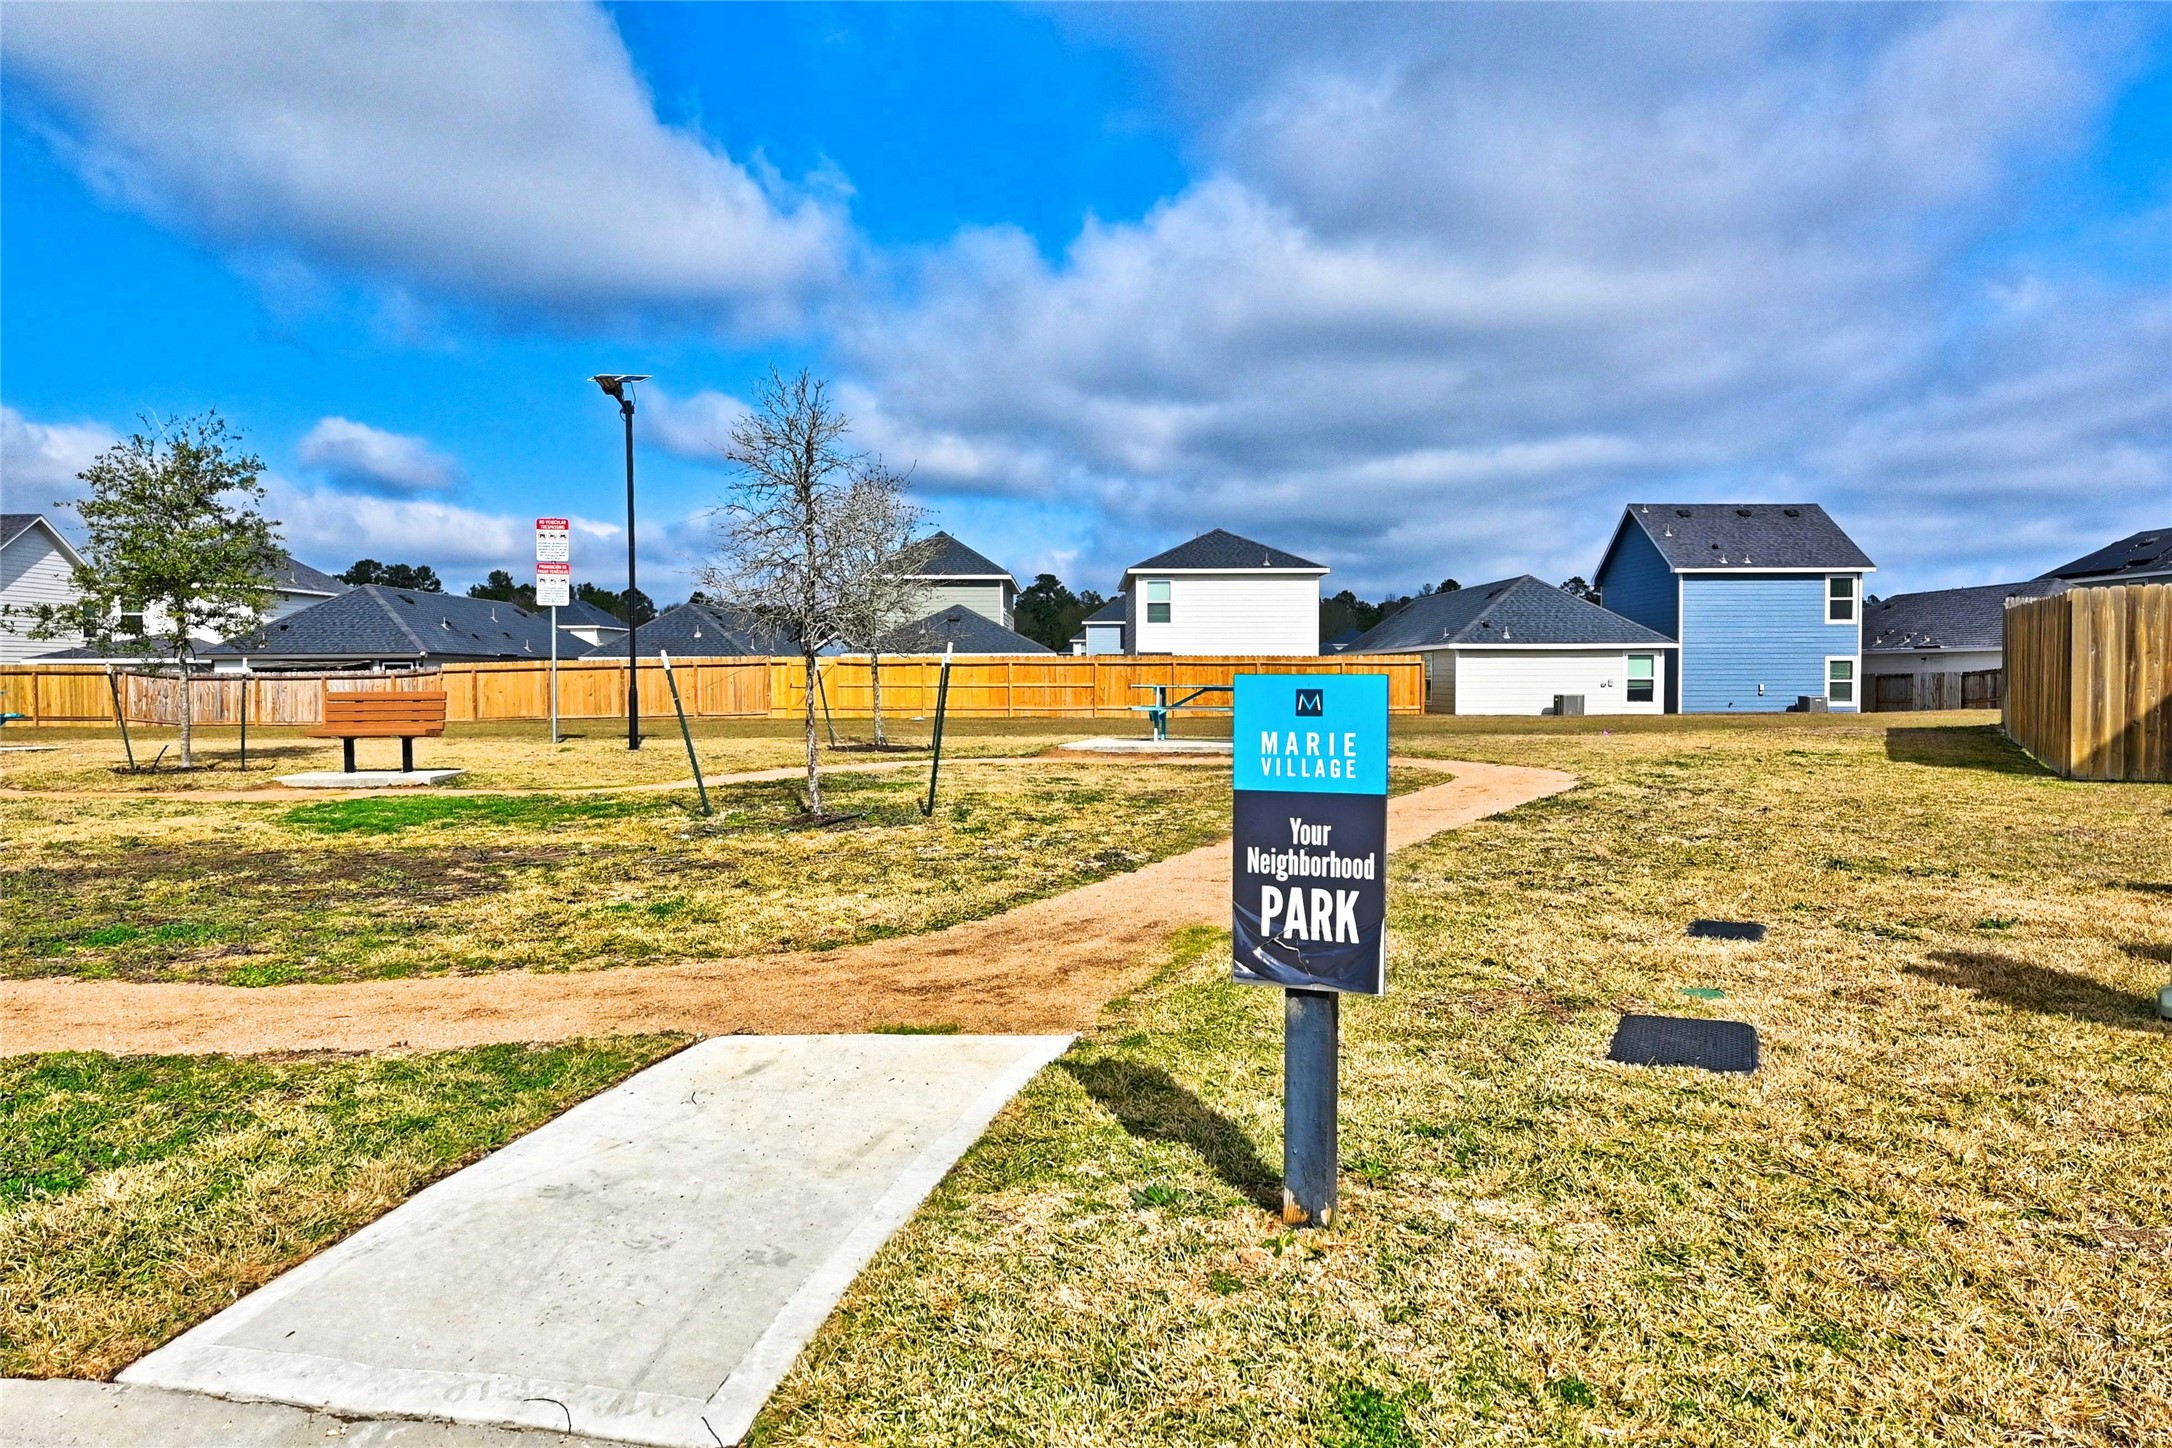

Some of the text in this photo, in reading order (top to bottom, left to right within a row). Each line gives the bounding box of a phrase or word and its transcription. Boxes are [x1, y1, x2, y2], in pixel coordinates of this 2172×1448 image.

[1298, 693, 1321, 711] M
[1260, 731, 1357, 757] MARIE
[1260, 757, 1357, 779] VILLAGE
[1289, 817, 1332, 846] Your
[1246, 847, 1375, 882] Neighborhood
[1260, 885, 1360, 944] PARK
